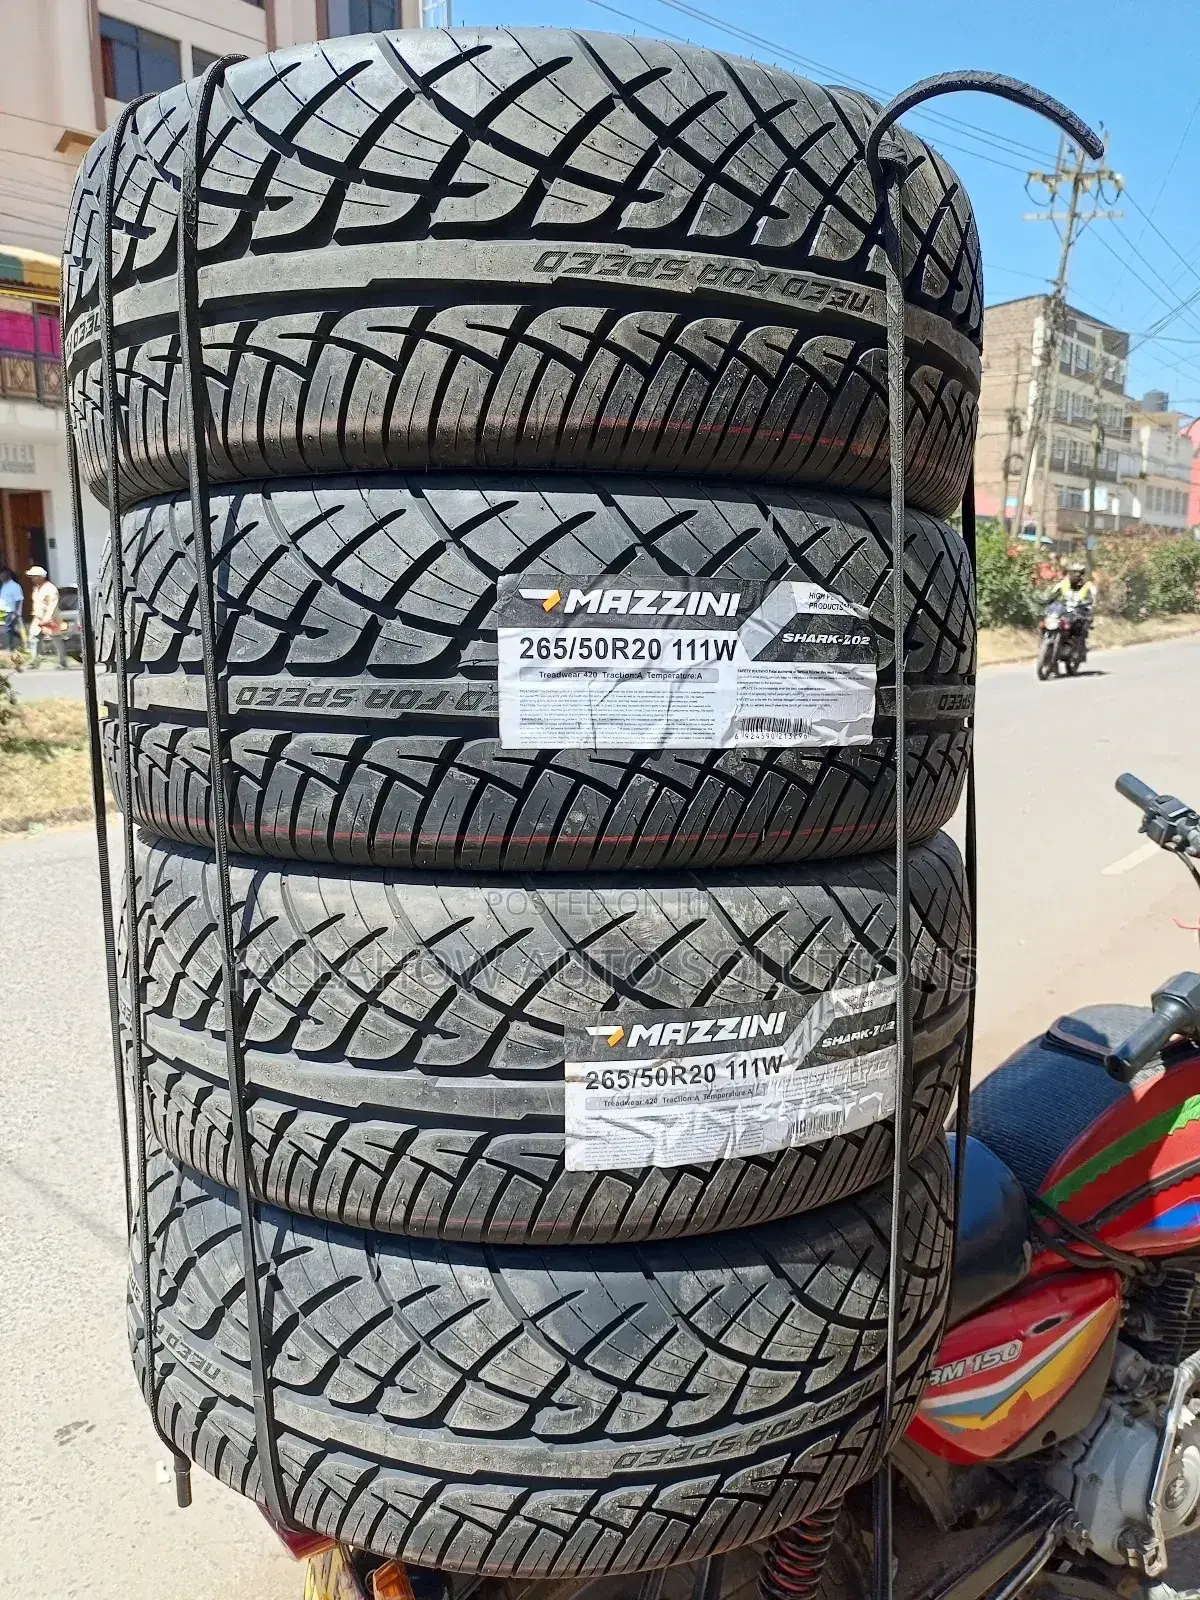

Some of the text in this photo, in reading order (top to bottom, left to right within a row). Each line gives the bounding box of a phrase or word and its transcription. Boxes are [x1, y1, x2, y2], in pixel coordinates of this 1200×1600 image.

[532, 251, 692, 282] SPEED
[563, 589, 742, 617] MAZZINI
[519, 636, 738, 662] 265/50R20 111W
[538, 671, 703, 681] Treadwear:420 Traction:A Temperature:A
[234, 686, 359, 708] SPEED
[363, 689, 452, 711] FOR
[627, 1010, 787, 1048] MAZZINI
[586, 1054, 785, 1090] 265/50R20 111W
[603, 1097, 658, 1107] Treadwear:420
[971, 1342, 1021, 1374] 150
[612, 1434, 742, 1470] SPEED
